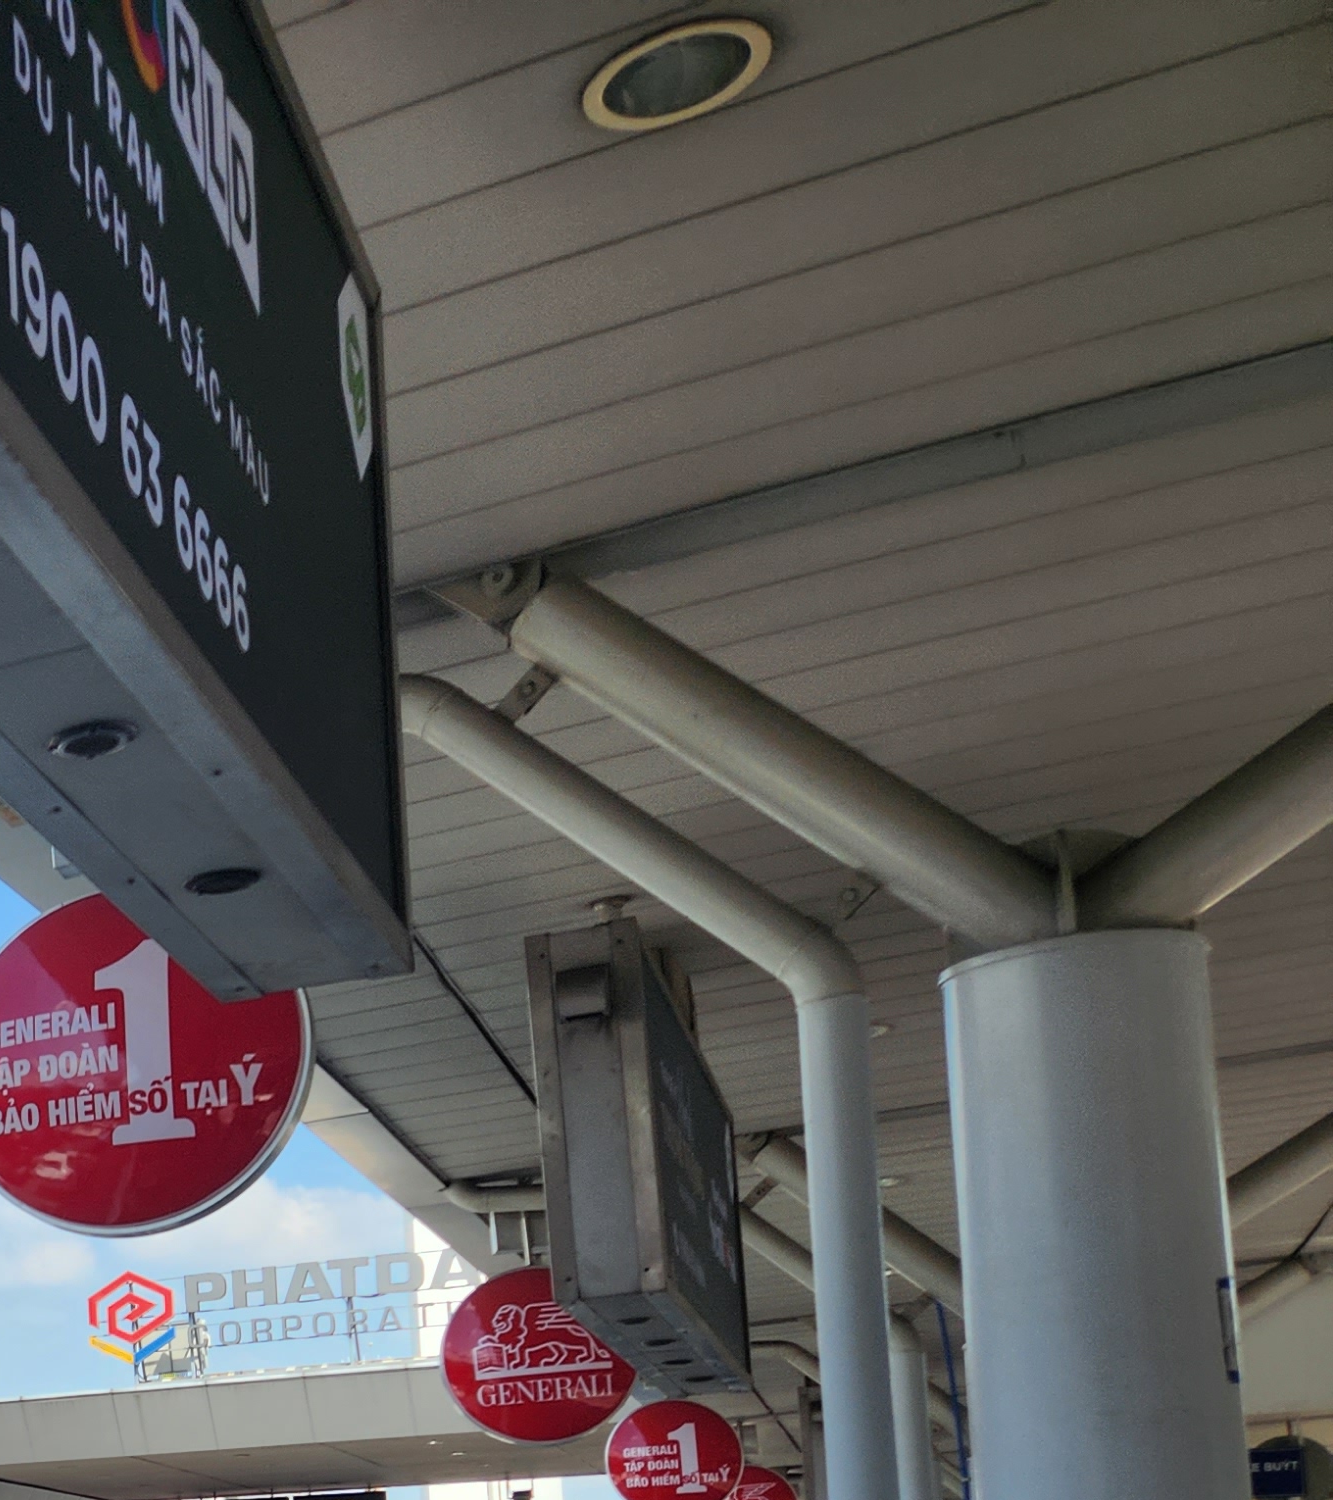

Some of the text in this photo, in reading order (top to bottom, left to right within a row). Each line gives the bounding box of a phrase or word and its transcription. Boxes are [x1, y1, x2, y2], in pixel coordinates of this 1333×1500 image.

[45, 0, 76, 58] O
[13, 13, 54, 135] DU
[67, 111, 129, 270] LỊCH
[139, 241, 172, 342] ĐA
[229, 400, 270, 507] MÀU
[1, 206, 251, 653] 1900 63 6666
[37, 1042, 119, 1083] ĐOÀN
[48, 1082, 121, 1127] HIỂM
[128, 1074, 173, 1116] SỐ
[181, 1078, 227, 1116] TẠI
[230, 1052, 263, 1106] Ý
[183, 1248, 483, 1313] PHATDA
[188, 1301, 455, 1350] CORPORATI
[476, 1373, 614, 1408] GENERALI
[623, 1444, 678, 1459] GENERALI
[623, 1457, 679, 1474] TẬP ĐOÀN
[625, 1473, 649, 1489] BẢO
